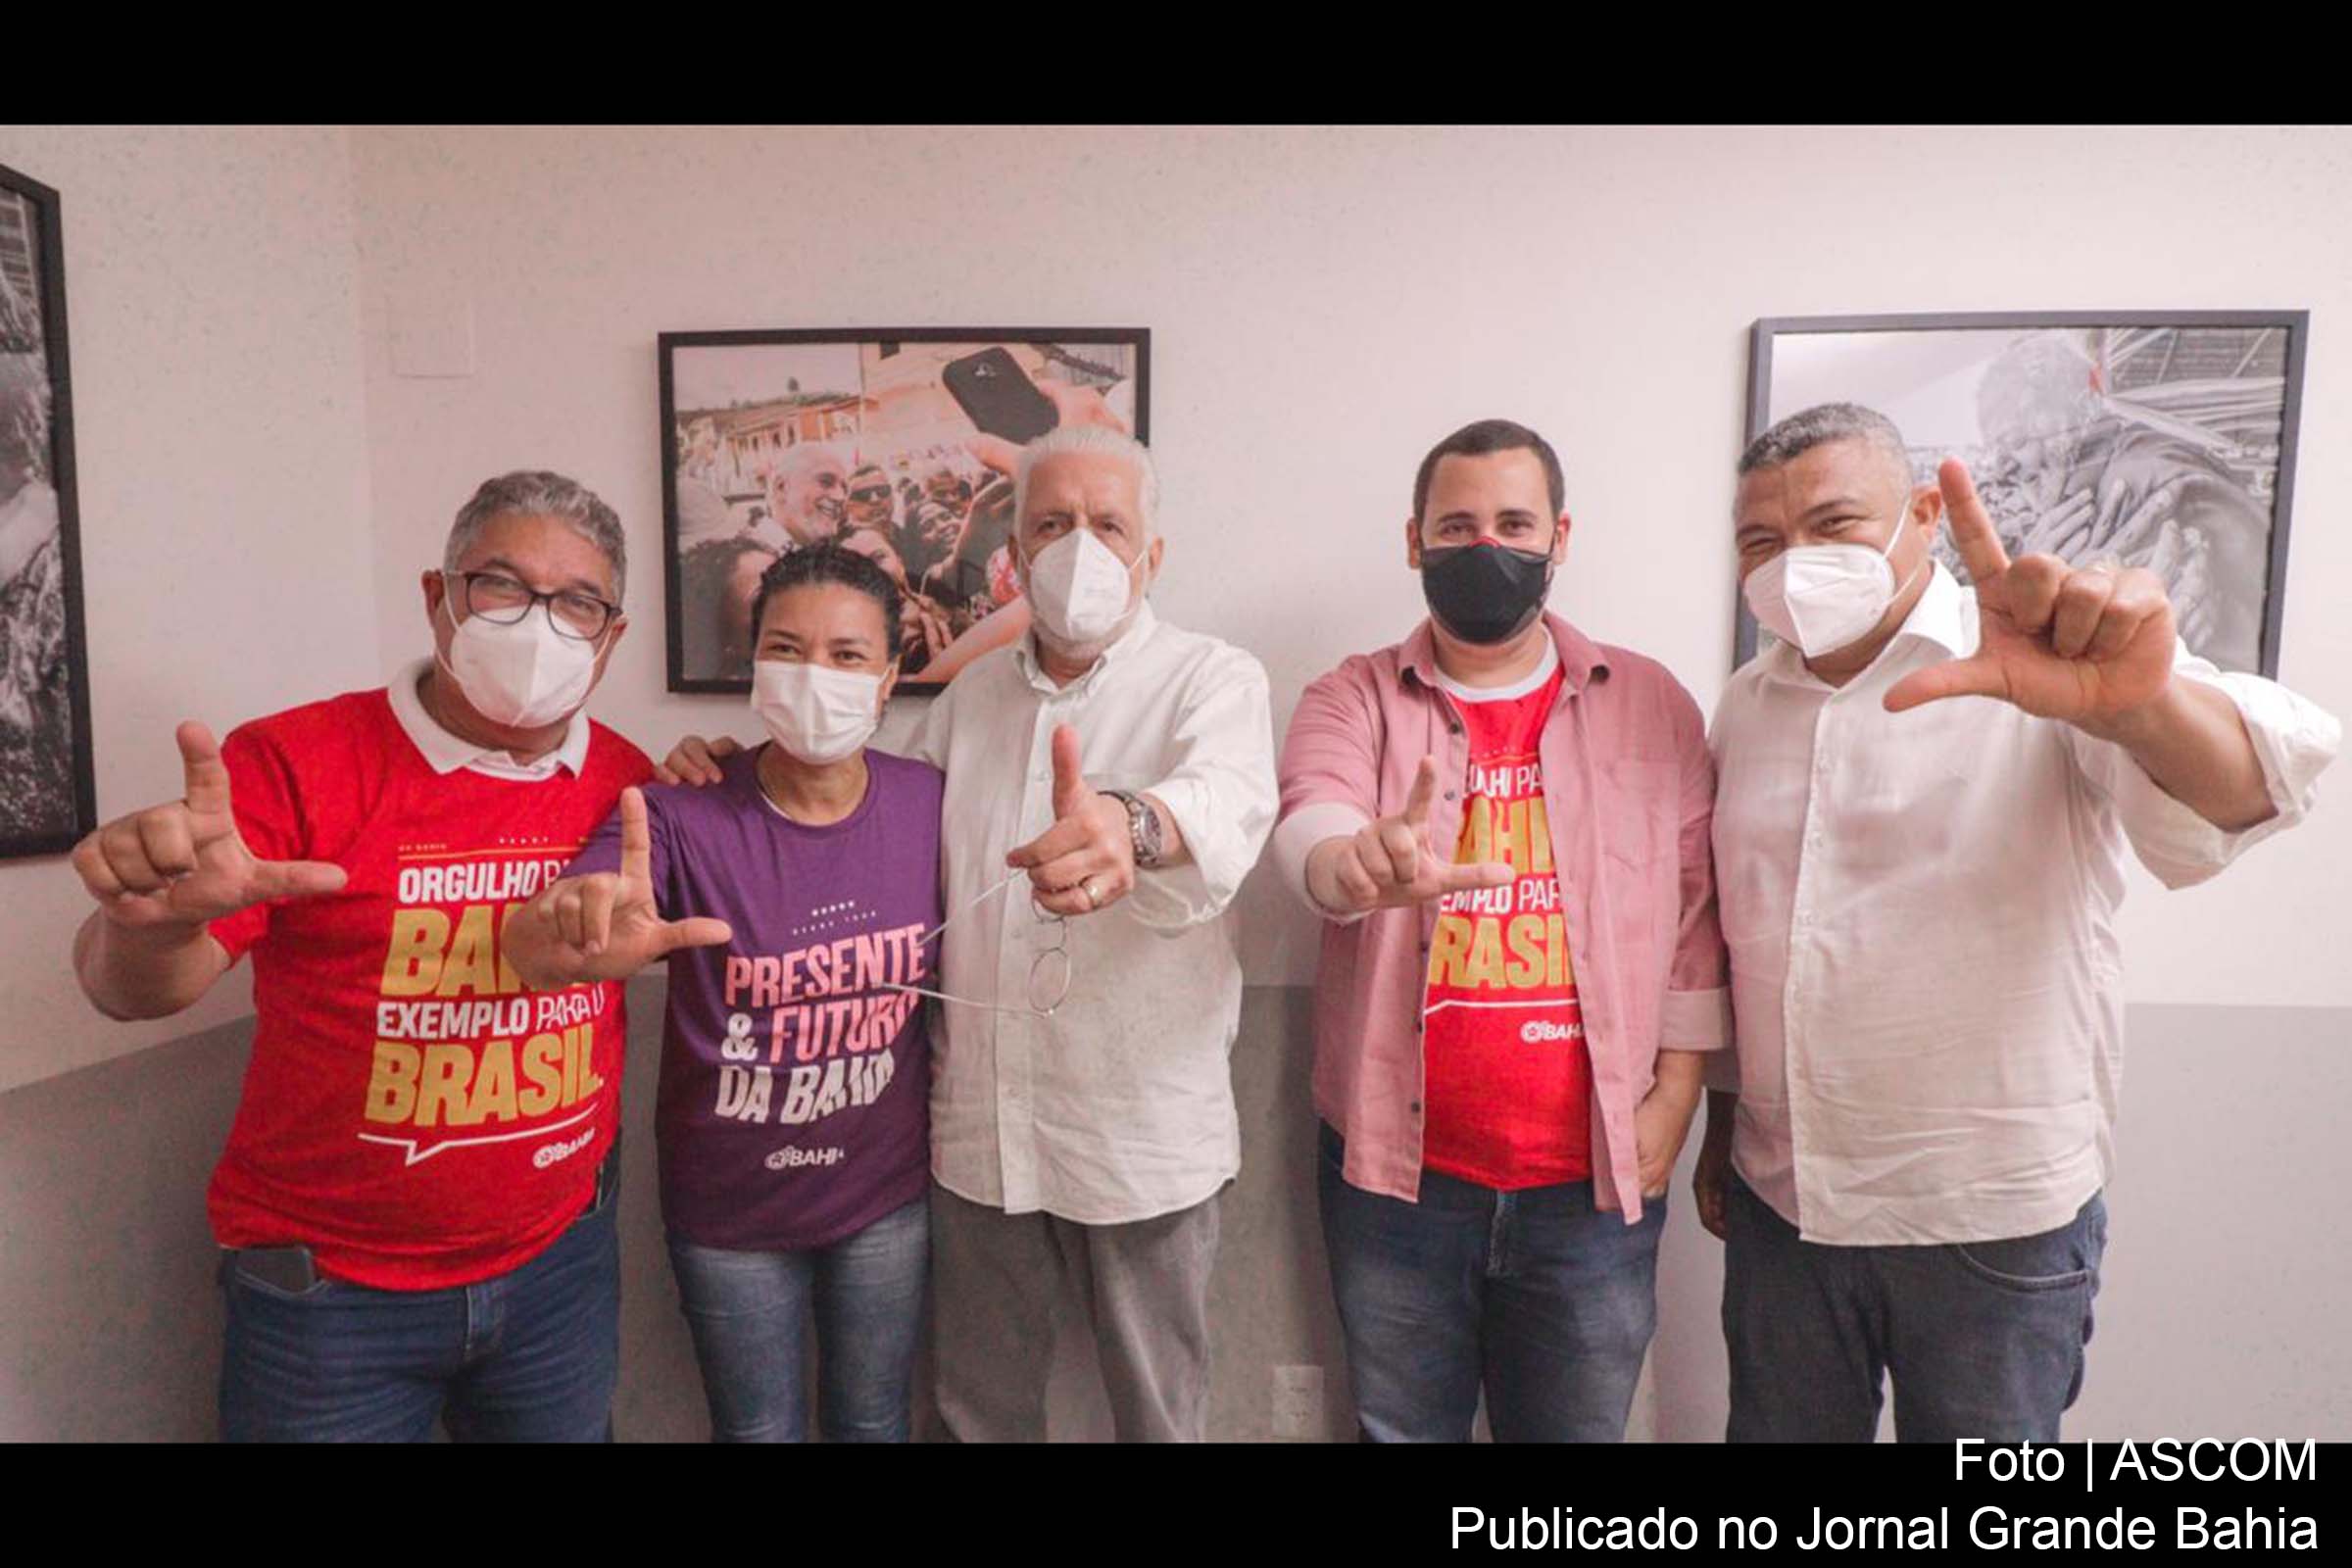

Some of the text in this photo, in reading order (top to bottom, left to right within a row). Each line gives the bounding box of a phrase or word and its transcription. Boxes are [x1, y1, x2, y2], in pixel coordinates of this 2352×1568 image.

[398, 858, 569, 904] ORGULHO P
[724, 923, 925, 1008] PRESENTE
[376, 997, 529, 1040] EXEMPLO
[535, 993, 591, 1032] PARA
[721, 1012, 759, 1061] &
[715, 1064, 774, 1124] DA
